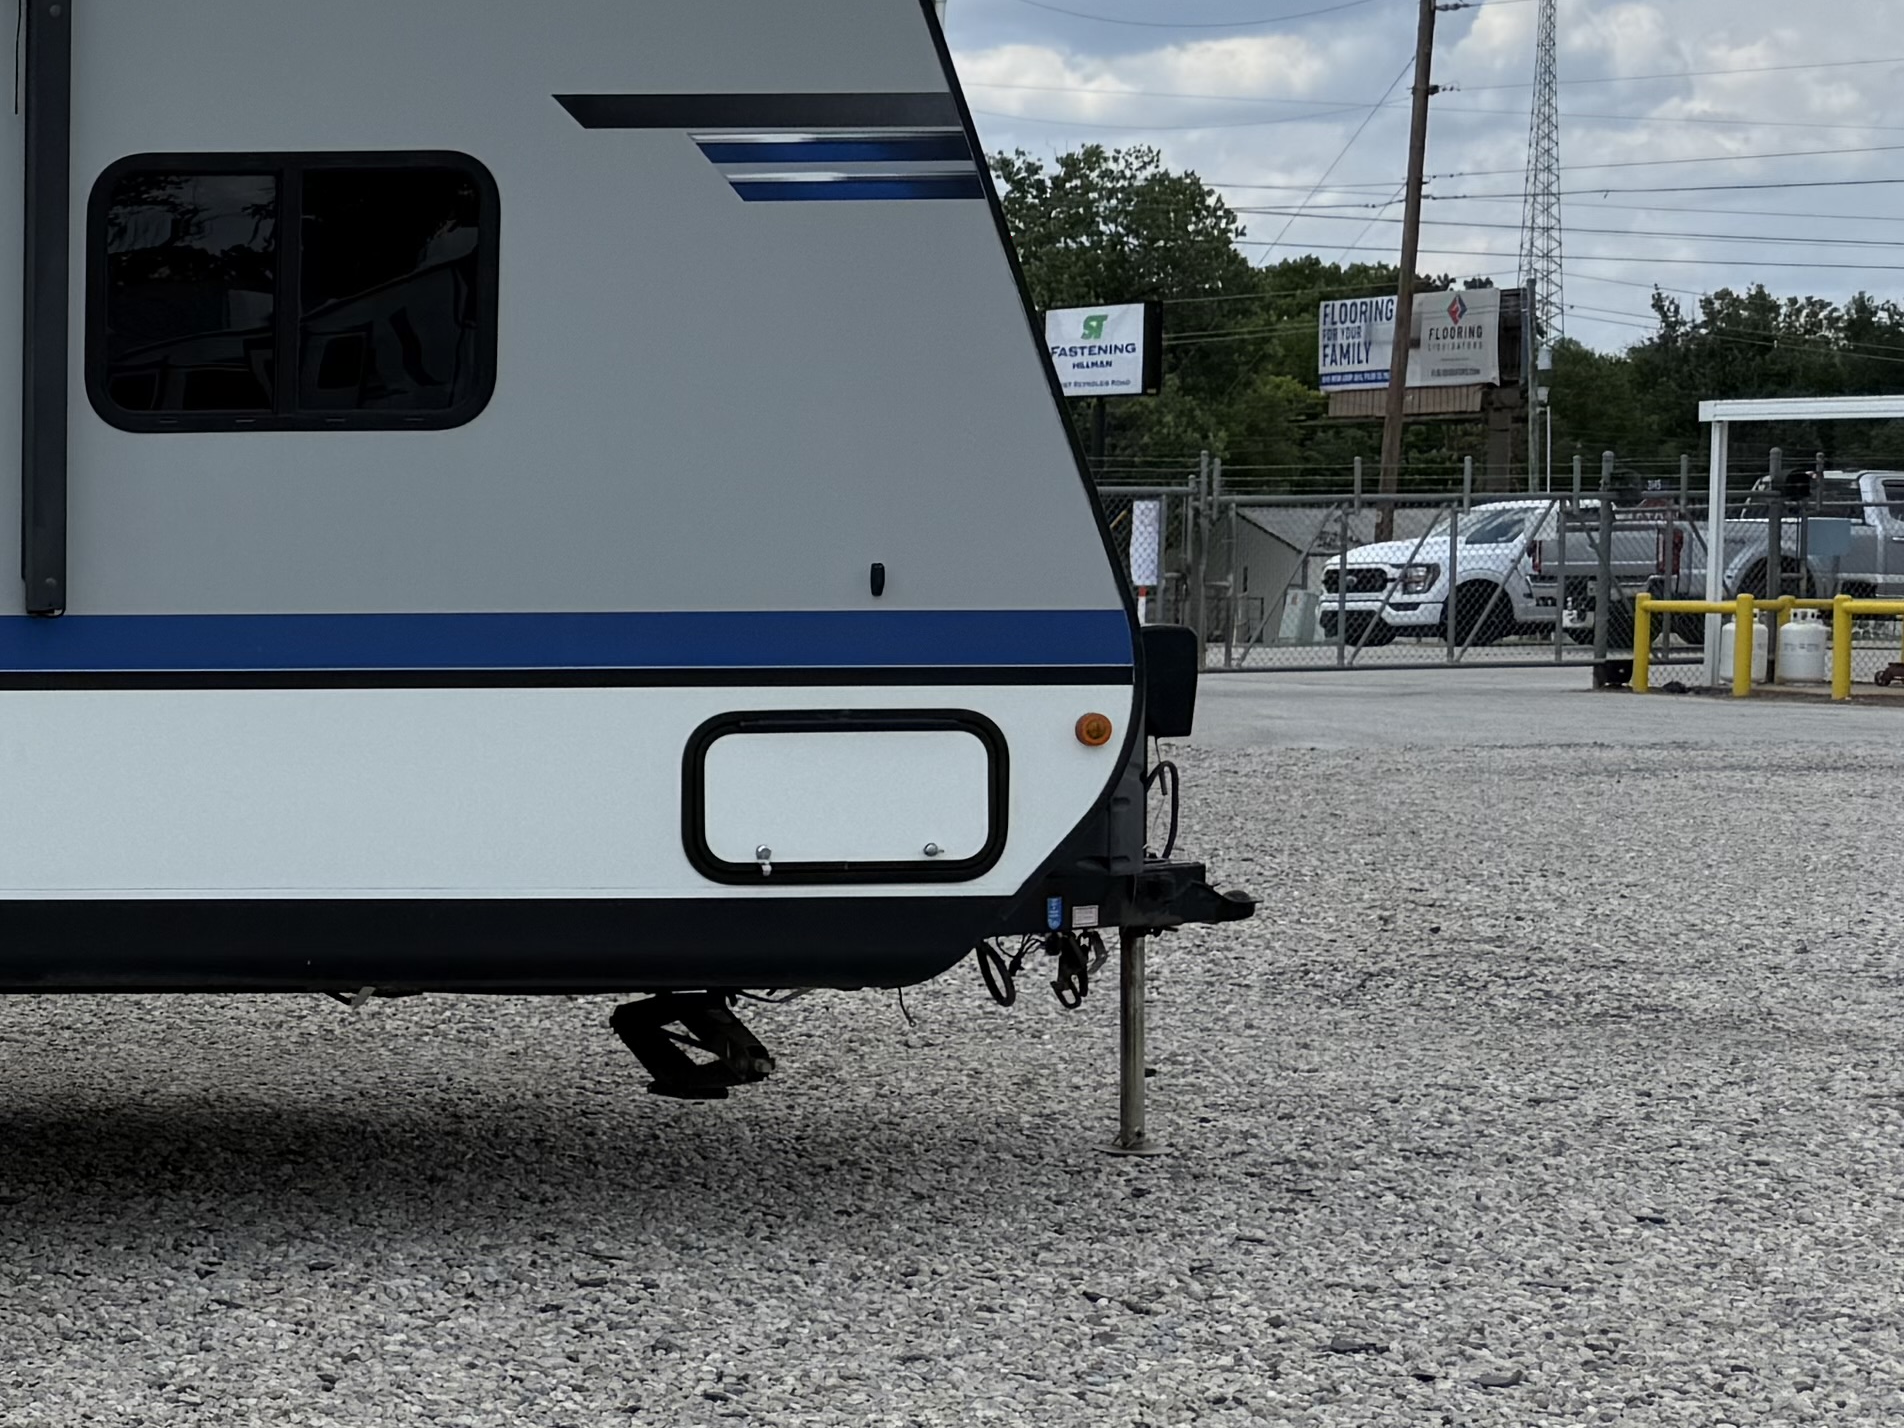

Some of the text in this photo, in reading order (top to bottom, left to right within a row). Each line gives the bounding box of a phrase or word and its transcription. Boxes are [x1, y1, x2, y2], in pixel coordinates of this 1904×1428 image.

[1323, 298, 1395, 326] FLOORING
[1340, 325, 1362, 341] YOUR
[1428, 324, 1483, 341] FLOORING
[1050, 343, 1136, 358] FASTENING
[1322, 340, 1372, 367] FAMILY
